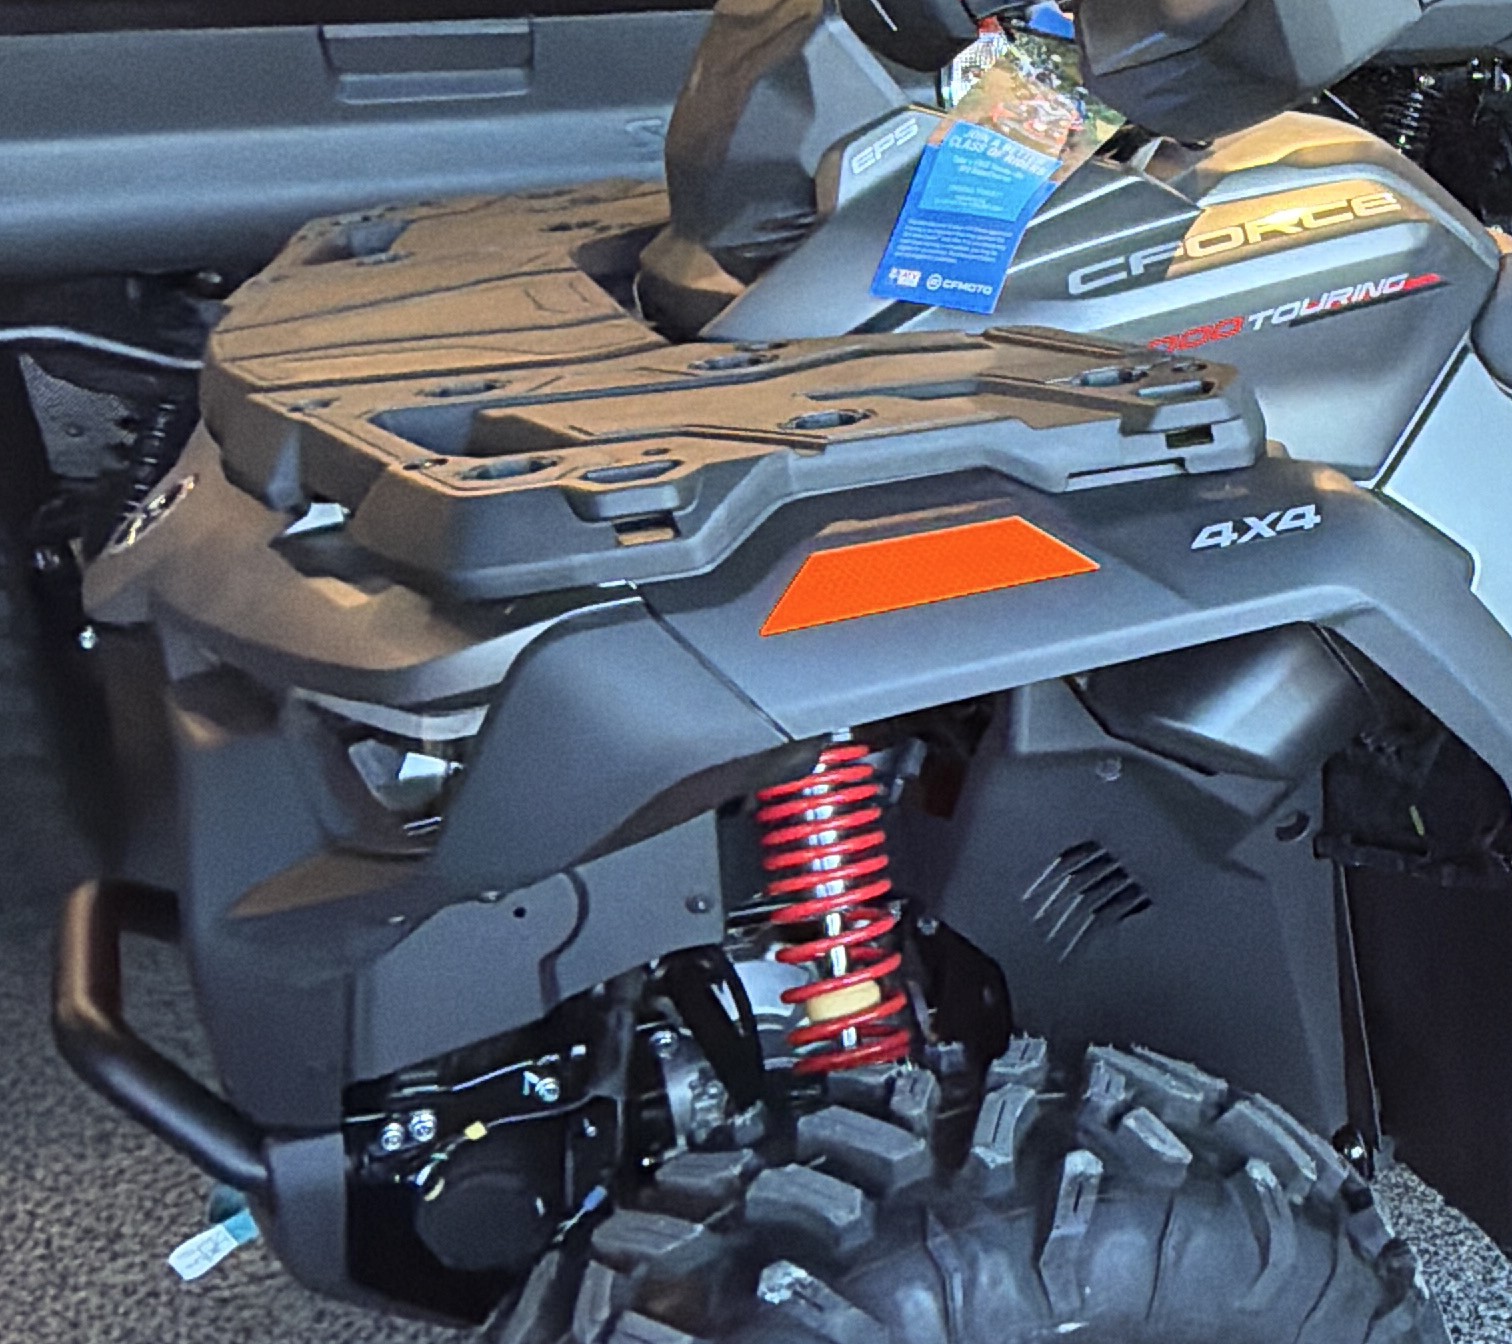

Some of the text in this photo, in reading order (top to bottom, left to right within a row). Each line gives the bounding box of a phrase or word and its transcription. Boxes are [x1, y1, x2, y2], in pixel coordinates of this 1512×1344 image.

[851, 117, 919, 174] EPS
[1067, 191, 1403, 297] CFORCE
[942, 278, 994, 296] CFMOTO
[1248, 272, 1410, 332] TOURING
